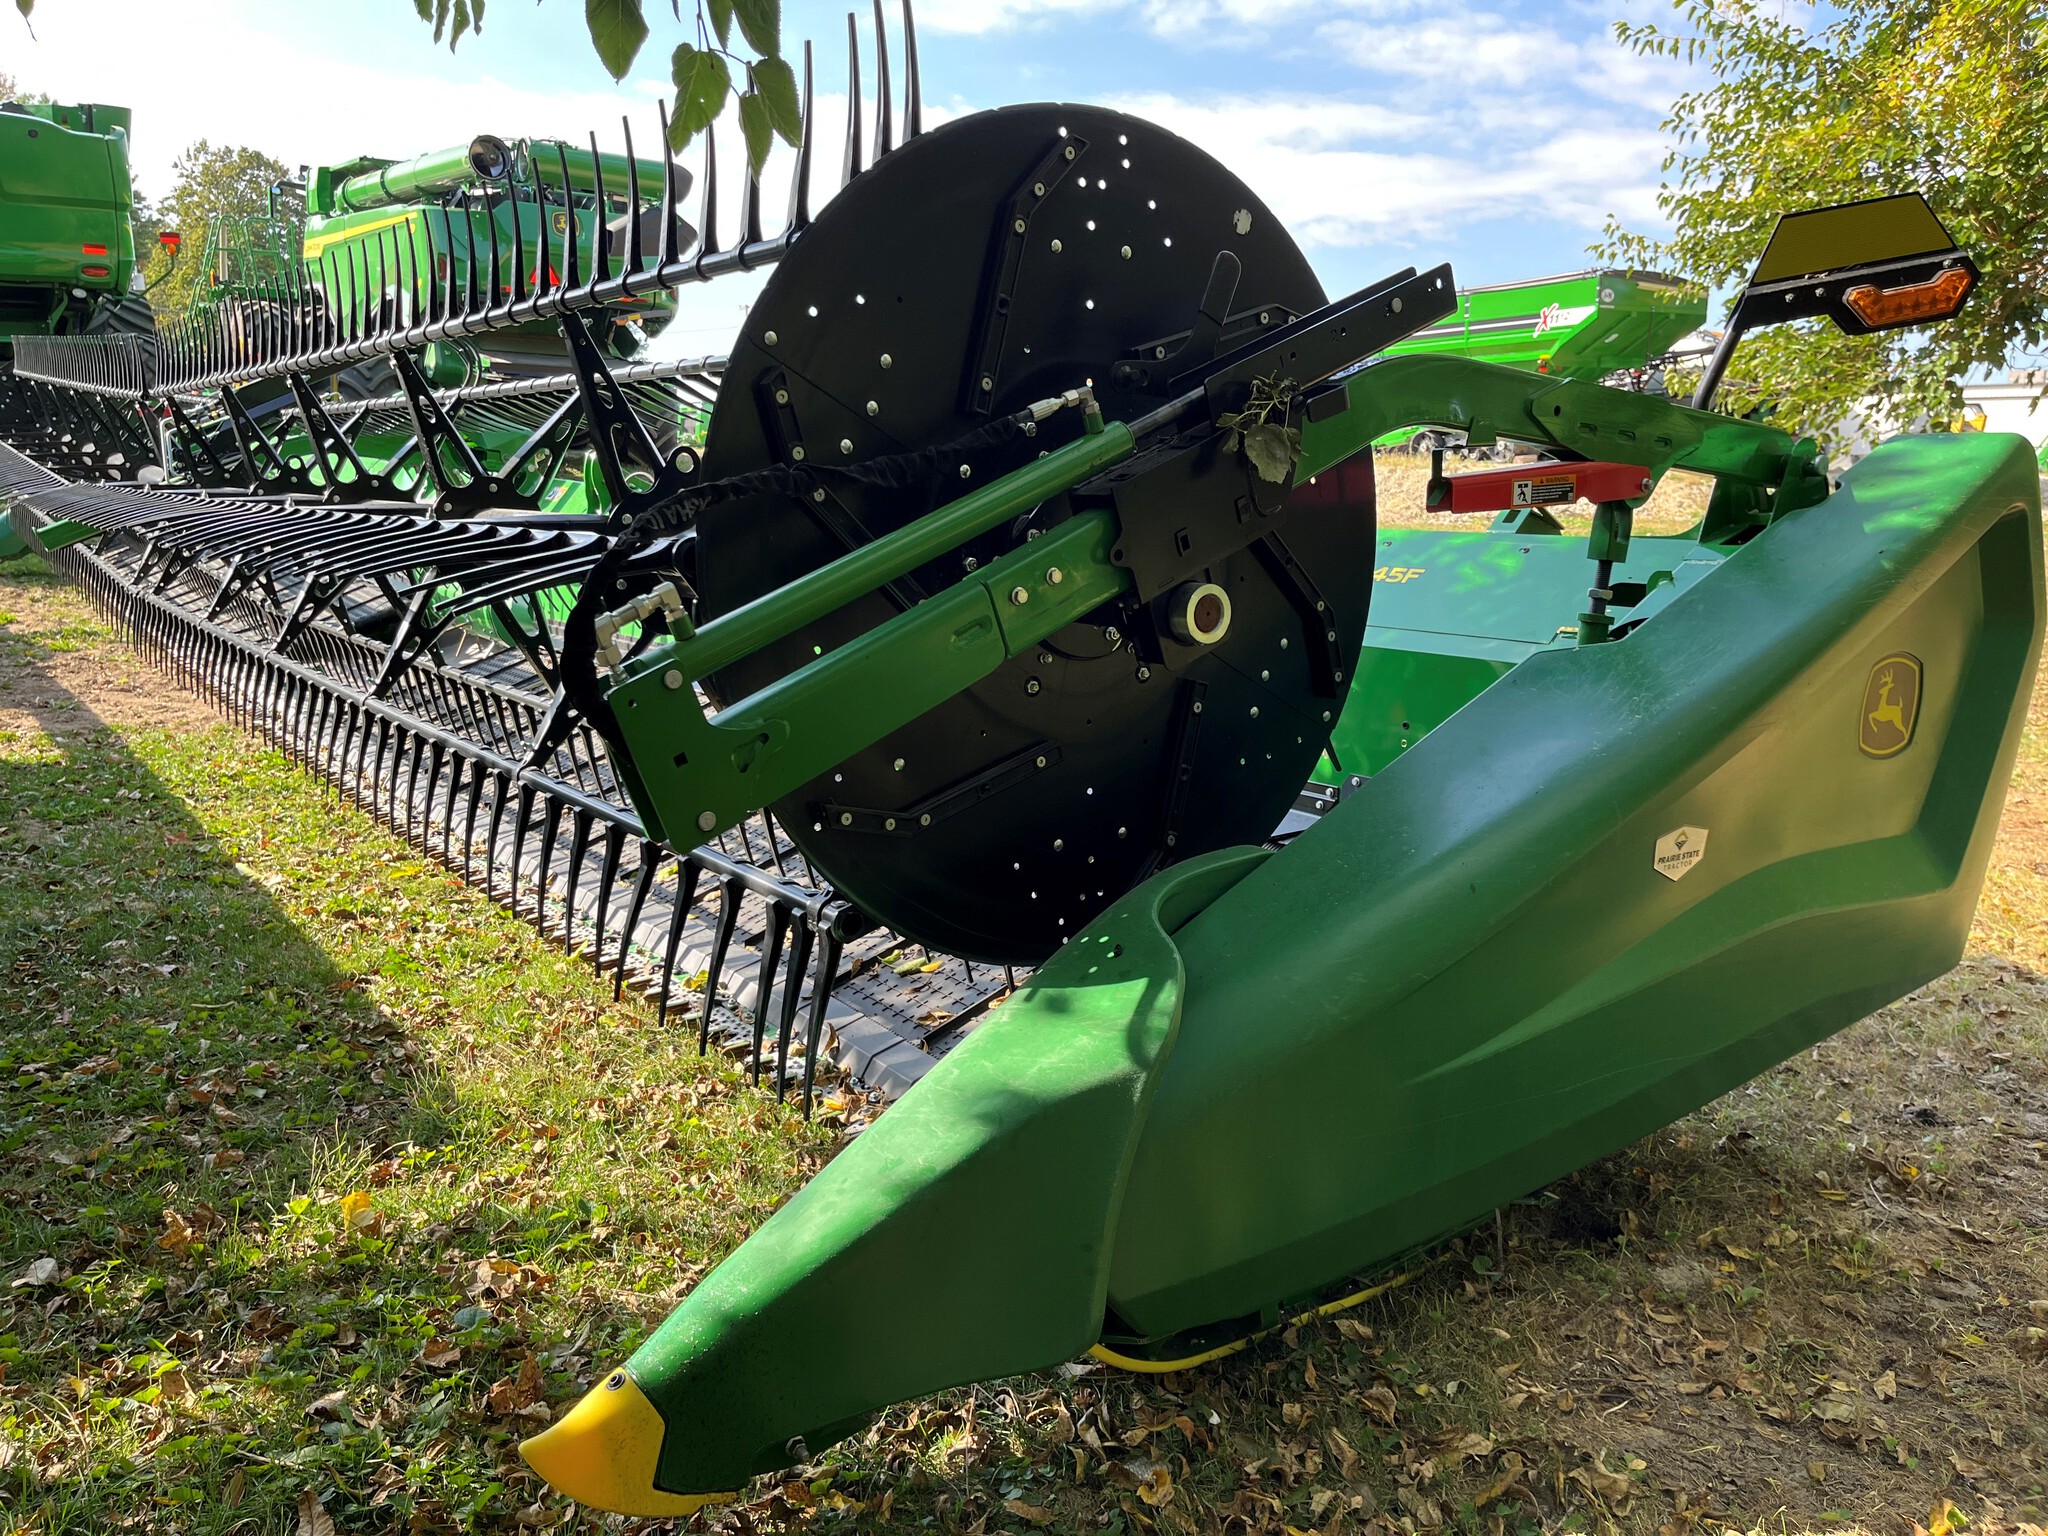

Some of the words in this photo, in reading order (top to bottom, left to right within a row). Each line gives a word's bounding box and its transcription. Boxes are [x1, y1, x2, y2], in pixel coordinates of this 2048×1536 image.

[1657, 853, 1681, 865] PRAIRIE
[1682, 850, 1700, 860] STATE
[1663, 859, 1693, 871] TRACTOR
